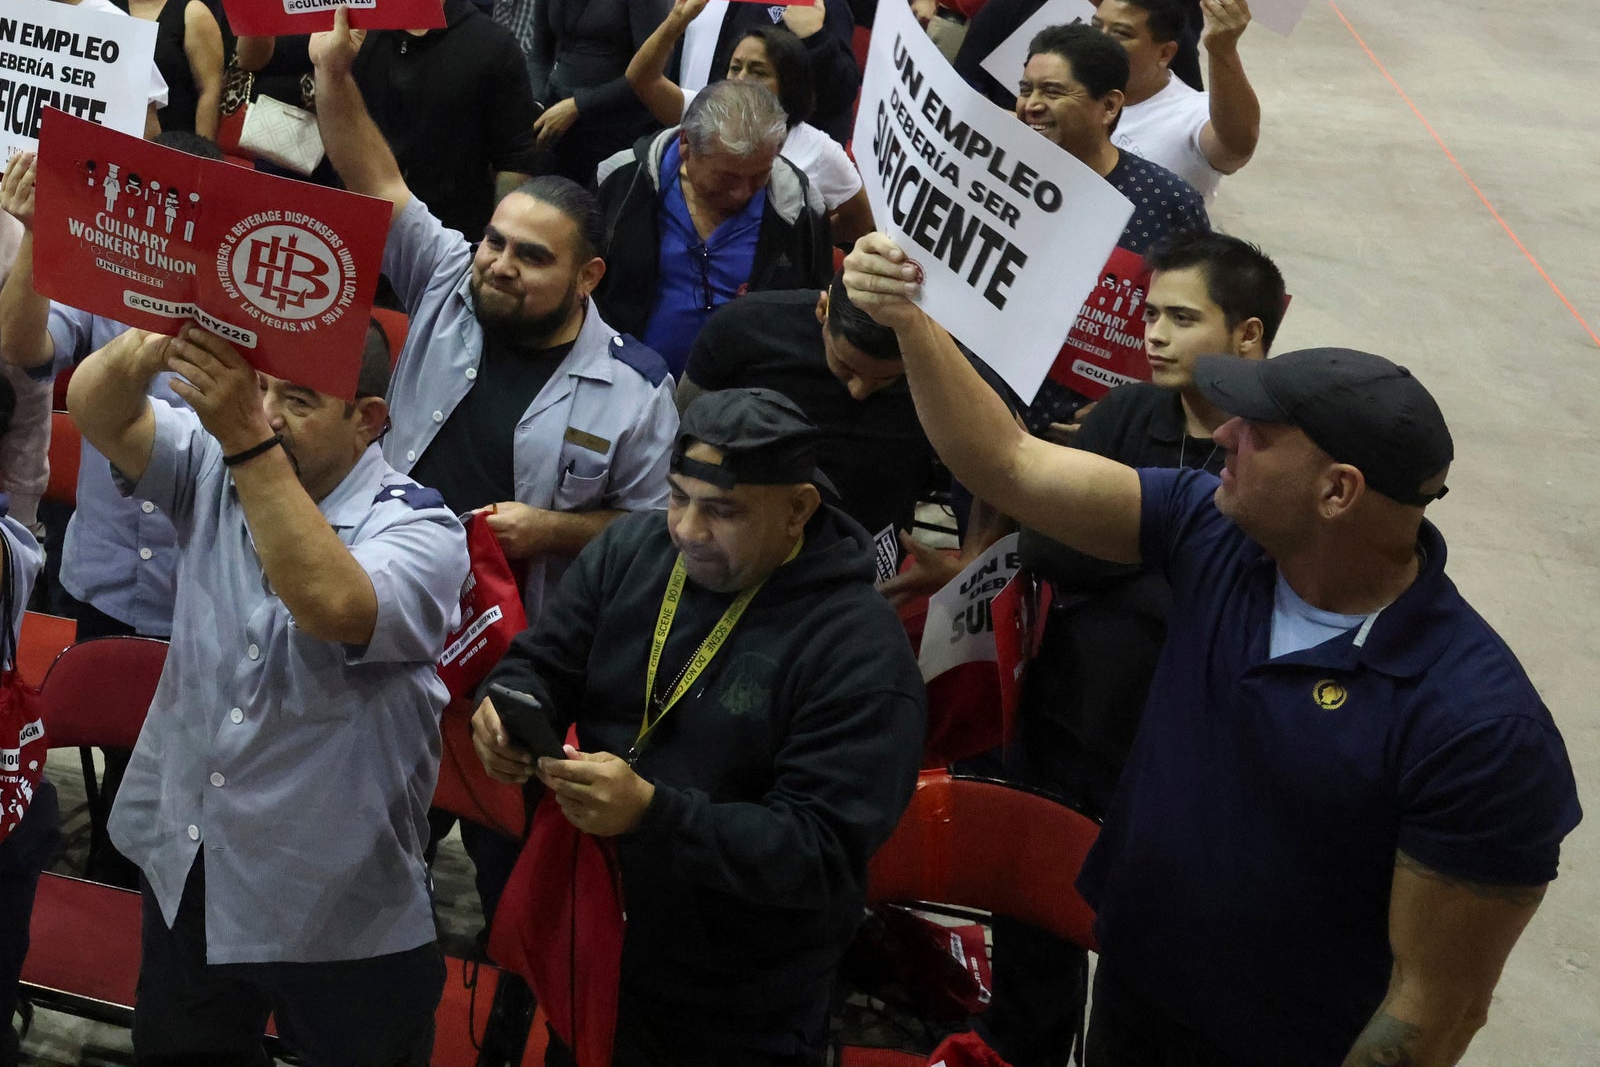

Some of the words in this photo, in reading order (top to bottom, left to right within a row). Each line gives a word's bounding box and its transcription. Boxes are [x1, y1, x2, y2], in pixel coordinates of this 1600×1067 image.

[19, 21, 120, 65] EMPLEO
[60, 66, 97, 89] SER
[892, 32, 924, 101] UN
[922, 86, 1063, 214] EMPLEO
[889, 85, 962, 190] DEBERÍA
[967, 179, 1021, 230] SER
[872, 96, 1028, 312] SUFICIENTE
[95, 211, 169, 253] CULINARY
[230, 210, 282, 237] BEVERAGE
[284, 210, 344, 249] DISPENSERS
[68, 217, 140, 260] WORKERS
[144, 247, 197, 276] UNION
[338, 247, 357, 277] UNION
[216, 242, 240, 300] BARTENDERS
[344, 278, 357, 308] LOCAL
[128, 295, 252, 344] @CULINARY226
[240, 301, 261, 320] LAS
[300, 320, 317, 332] NV
[1079, 305, 1128, 331] ULINARY
[1103, 328, 1144, 350] UNION
[672, 569, 685, 589] NOT
[959, 557, 998, 595] UN
[668, 587, 678, 603] DO
[658, 607, 673, 638] SCENE
[705, 624, 727, 652] SCENE
[650, 636, 664, 668] CRIME
[695, 655, 706, 668] DO
[684, 667, 698, 685] NOT
